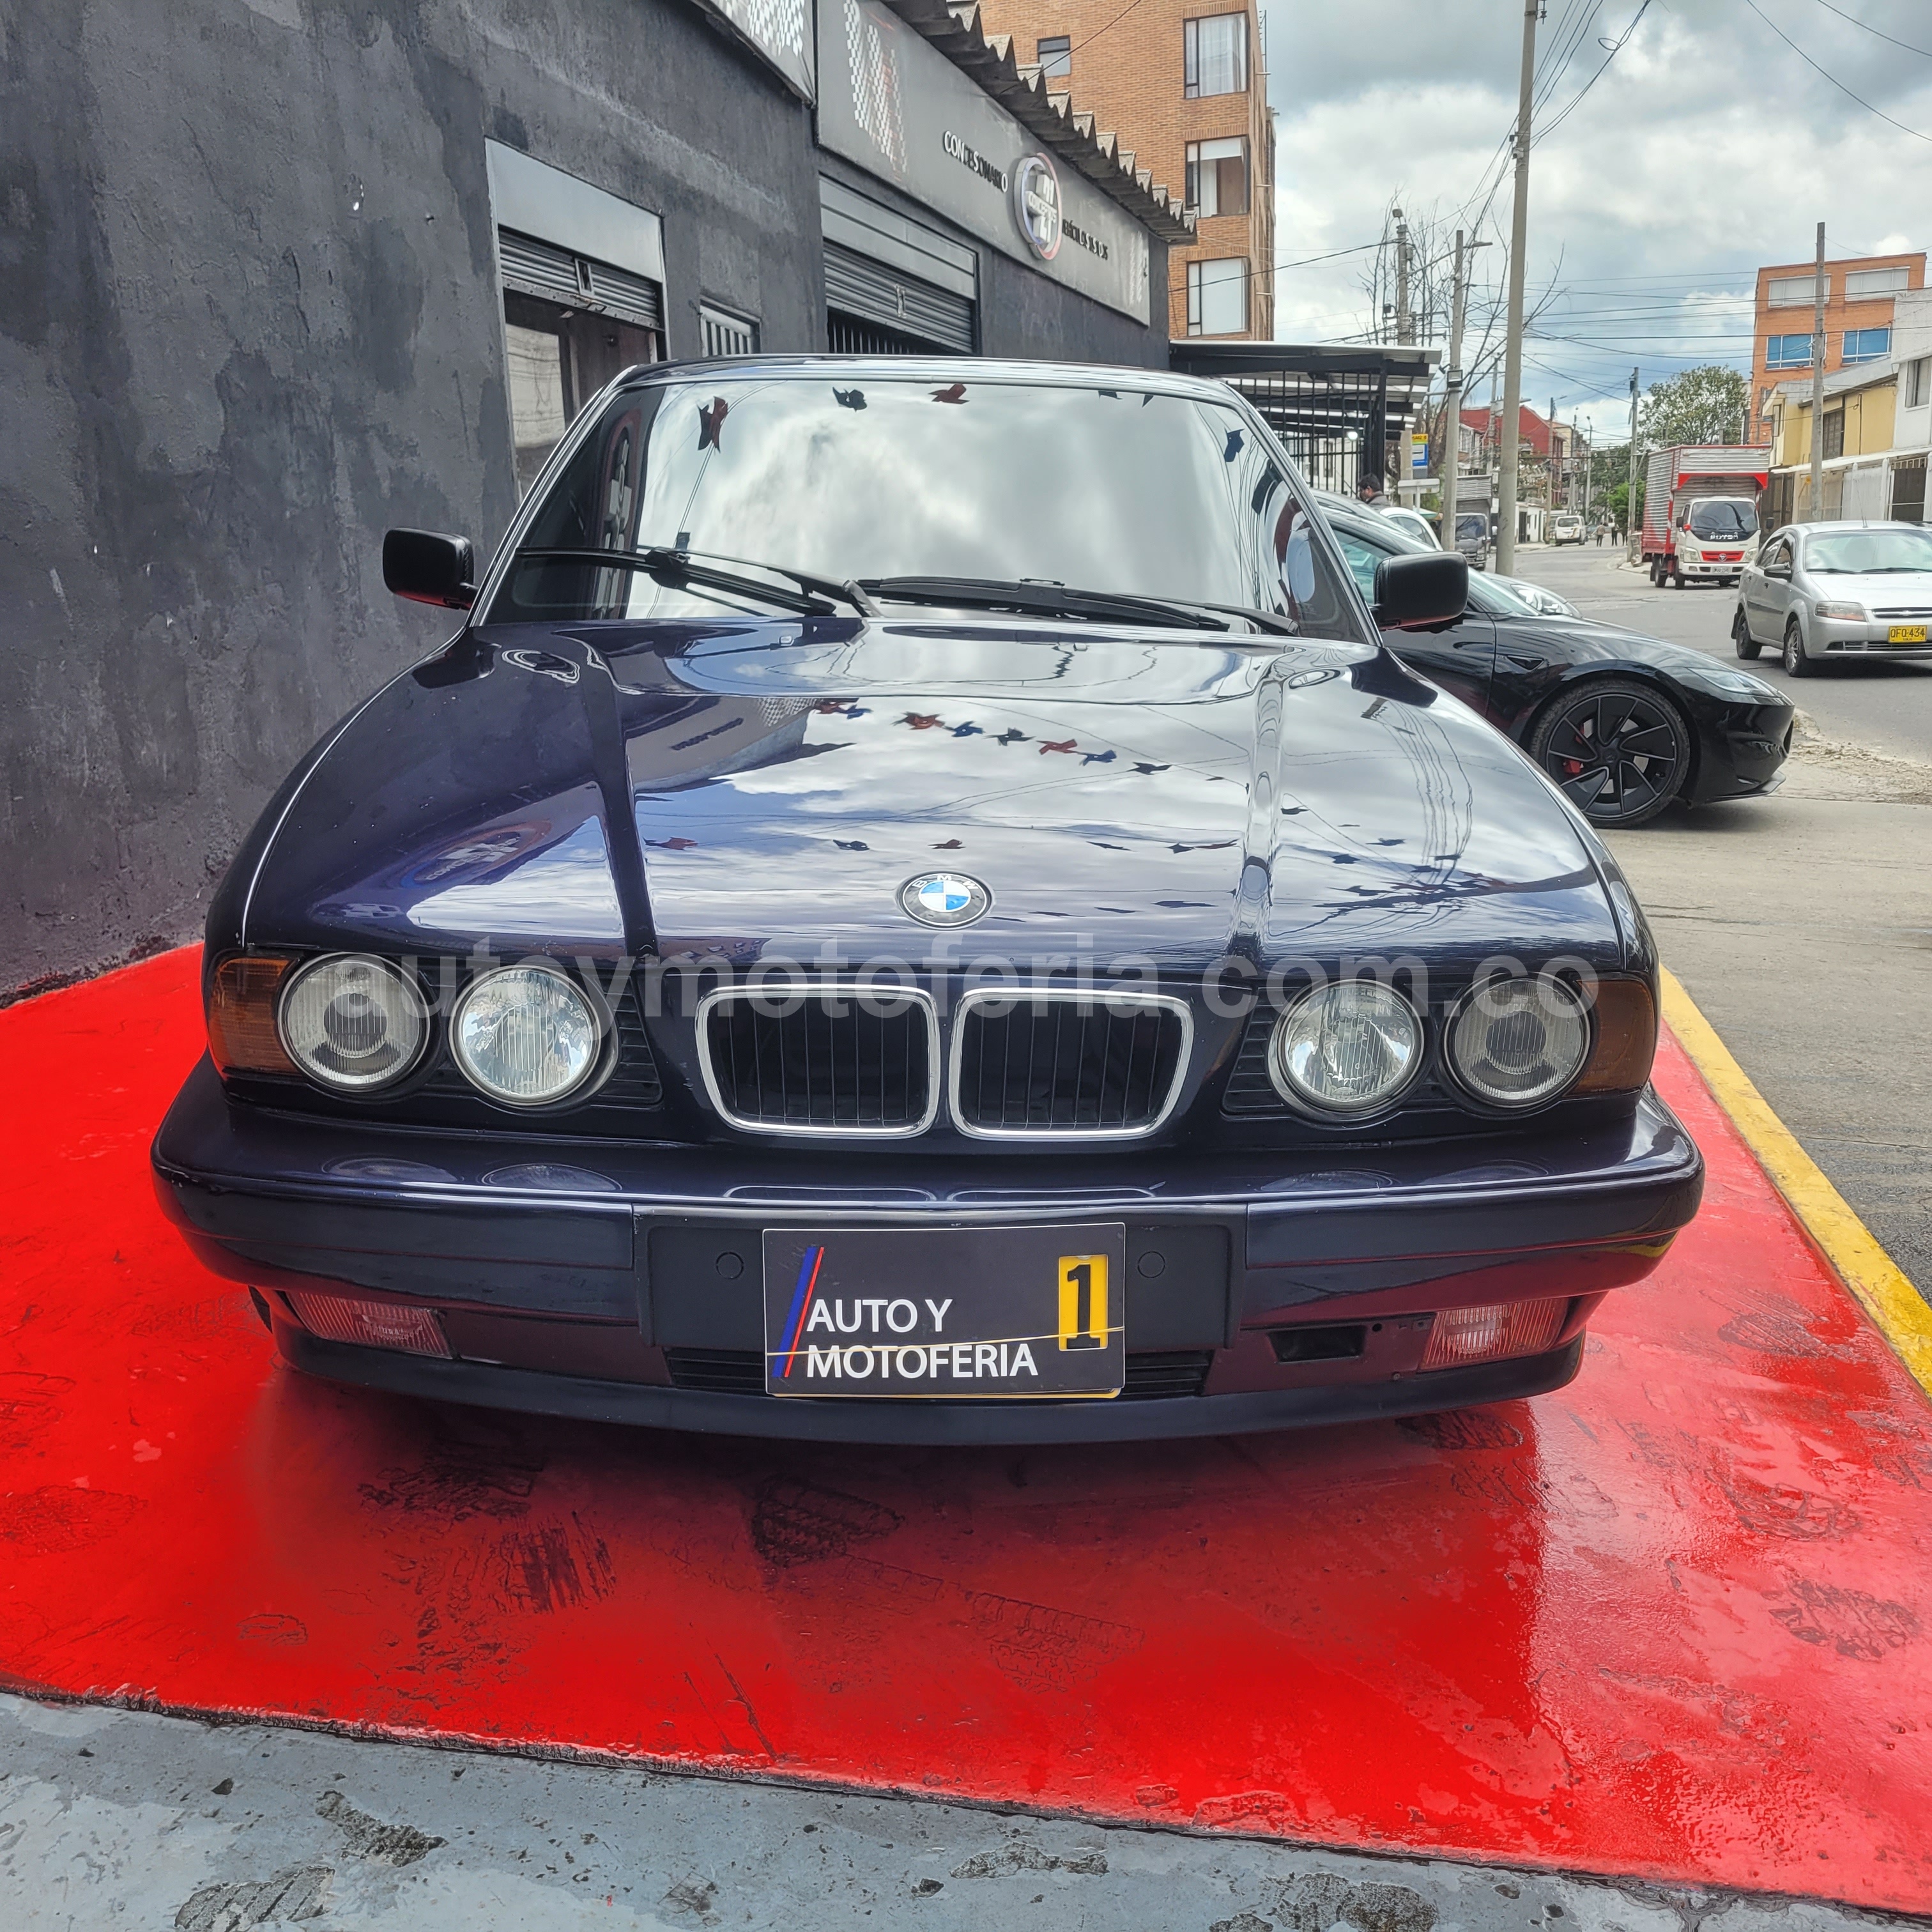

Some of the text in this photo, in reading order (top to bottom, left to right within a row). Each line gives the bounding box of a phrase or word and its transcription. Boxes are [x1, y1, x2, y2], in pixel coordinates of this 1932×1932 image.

[912, 875, 979, 890] BMW
[806, 1299, 953, 1333] AUTO Y
[1066, 1264, 1101, 1349] 1
[806, 1343, 1038, 1378] MOTOFERIA
